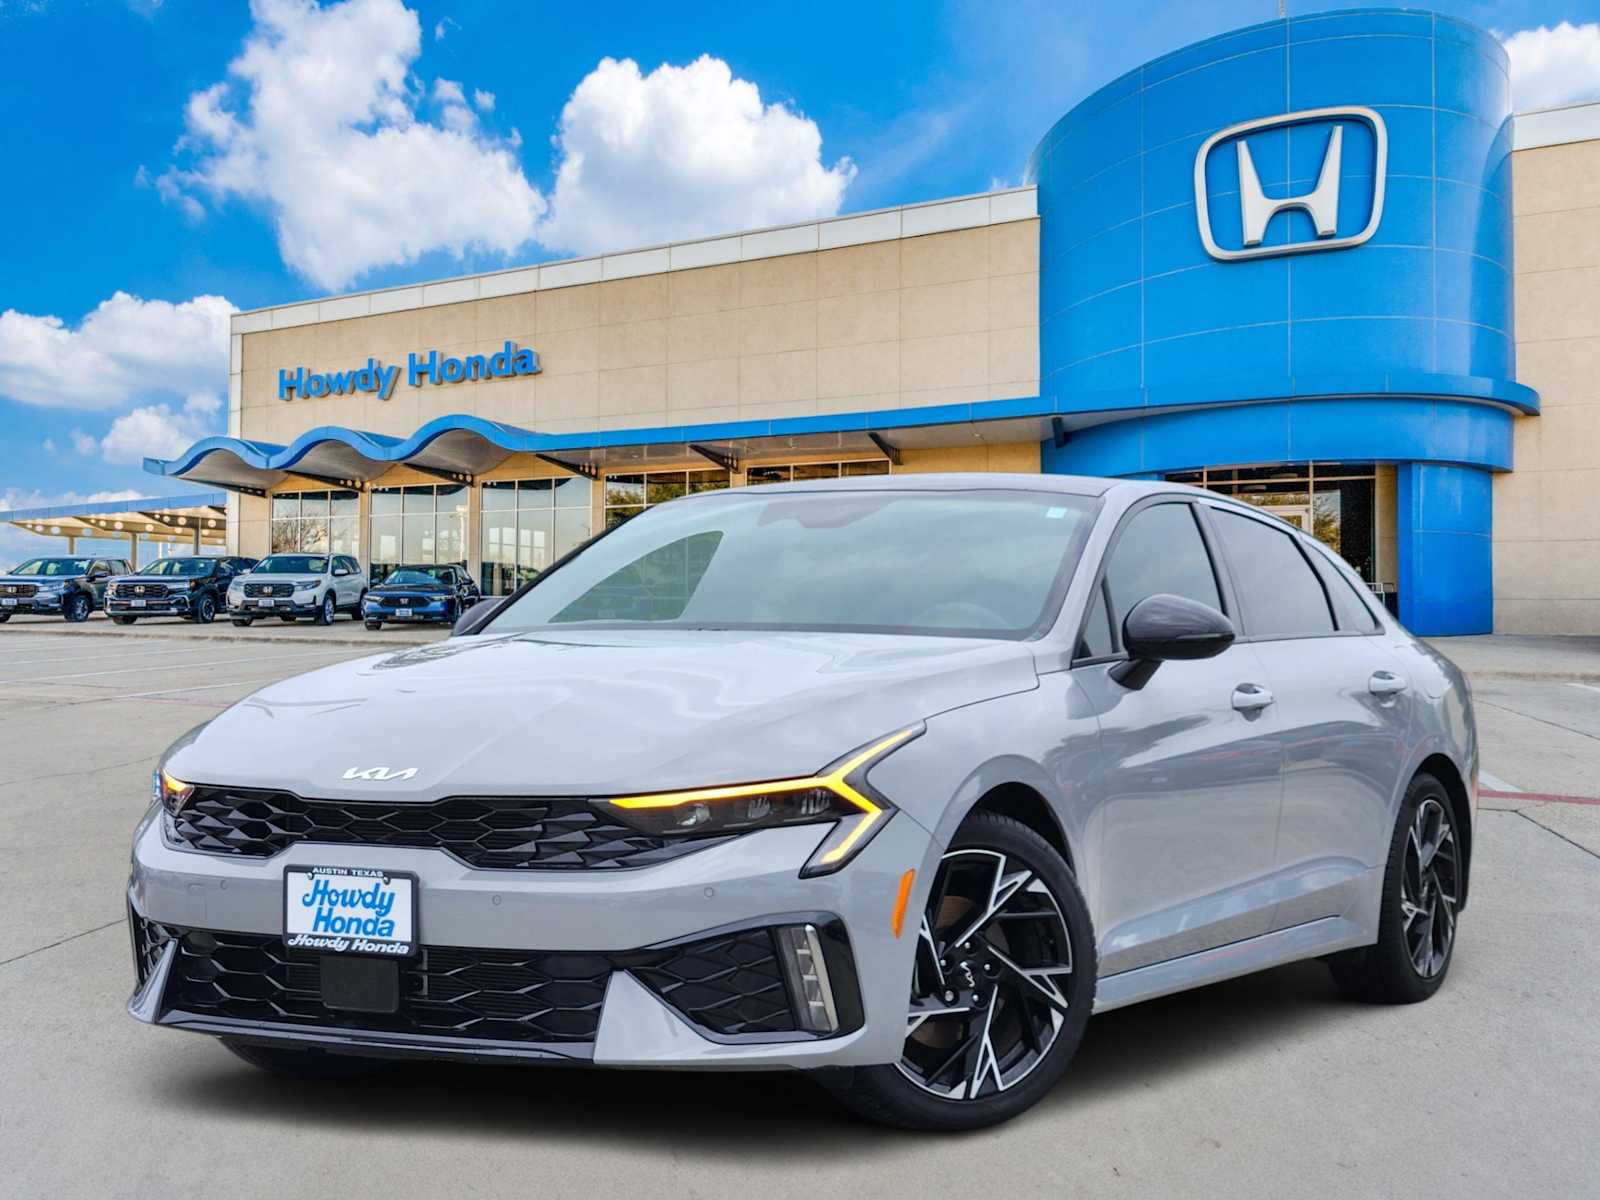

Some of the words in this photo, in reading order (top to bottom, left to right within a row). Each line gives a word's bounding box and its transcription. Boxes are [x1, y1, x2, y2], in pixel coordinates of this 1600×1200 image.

[278, 357, 400, 401] Howdy
[407, 340, 541, 388] Honda
[312, 867, 348, 875] AUSTIN
[351, 869, 384, 877] TEXAS
[302, 879, 395, 917] Howdy
[312, 907, 395, 937] Honda
[287, 934, 350, 952] Howdy
[351, 938, 409, 955] Honda
